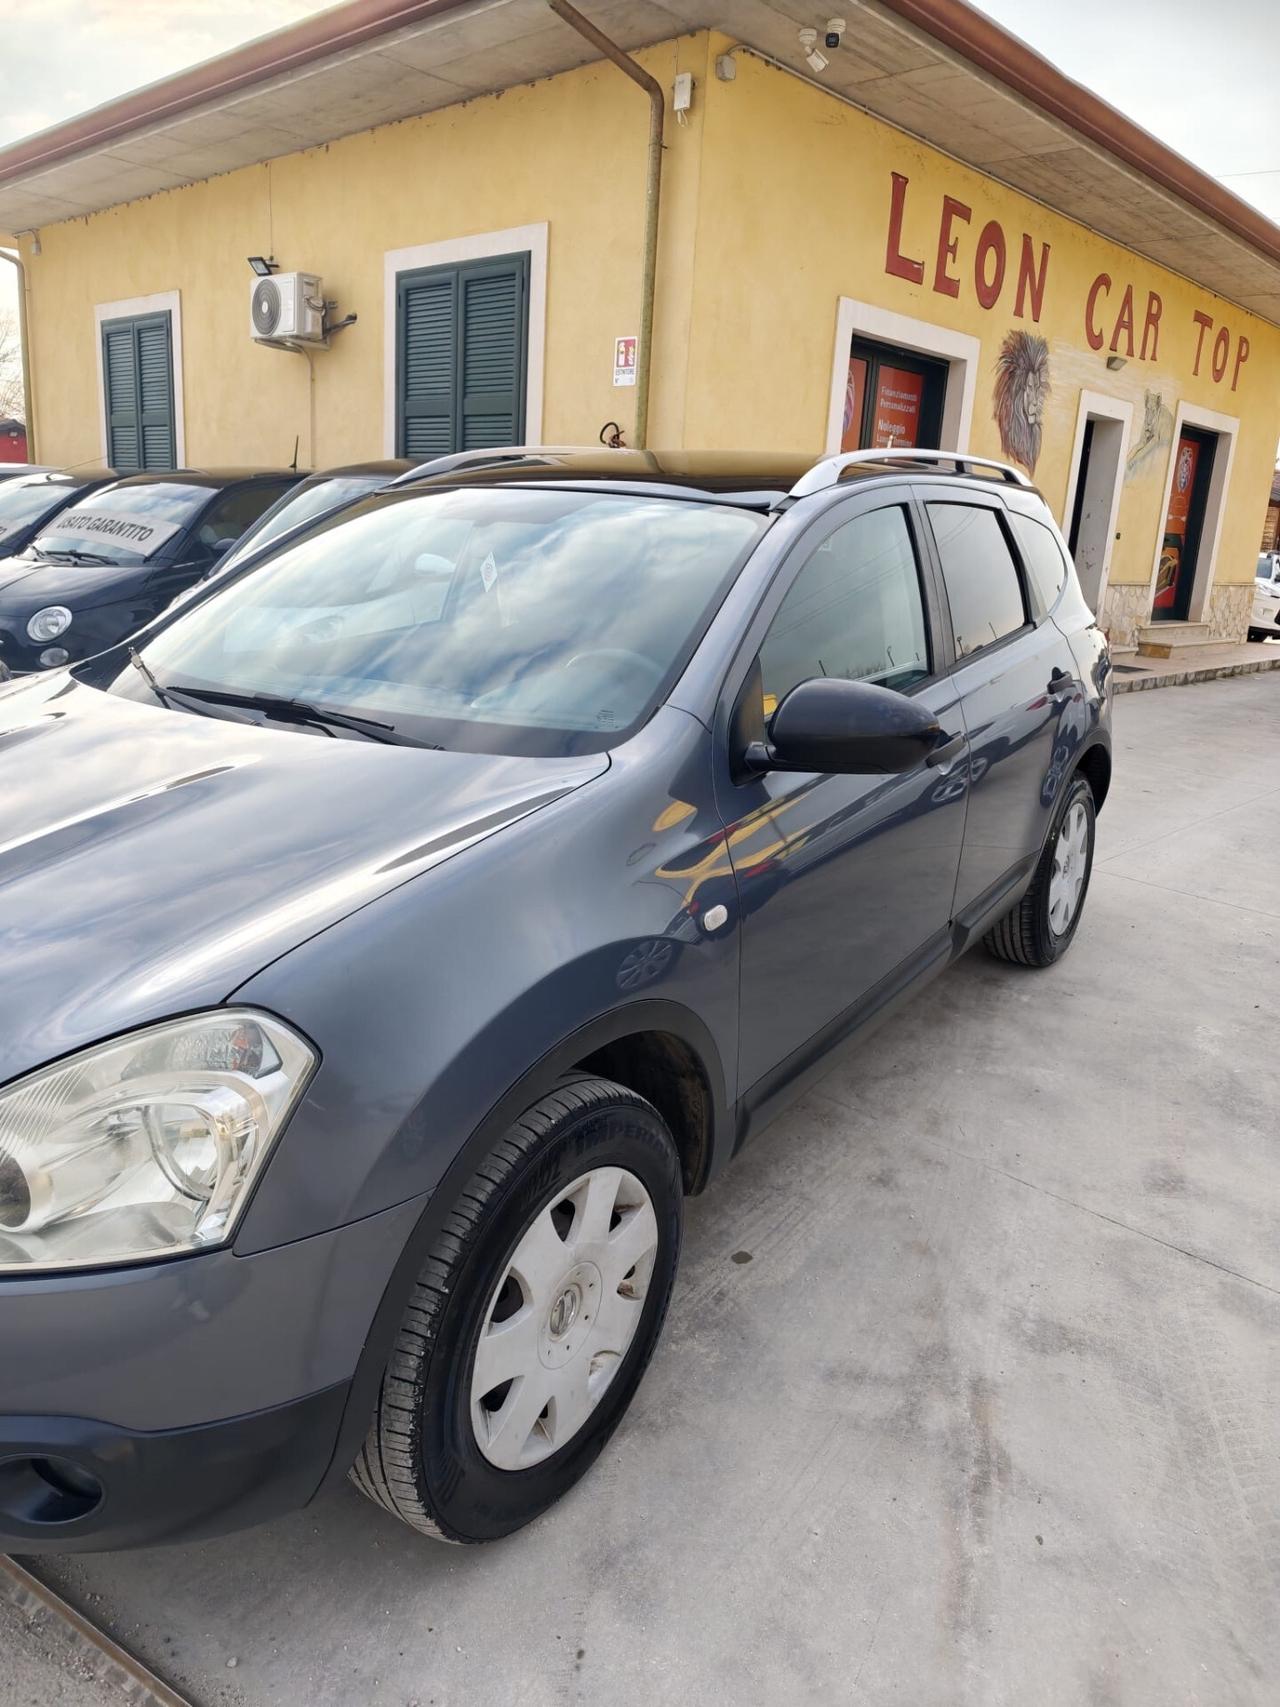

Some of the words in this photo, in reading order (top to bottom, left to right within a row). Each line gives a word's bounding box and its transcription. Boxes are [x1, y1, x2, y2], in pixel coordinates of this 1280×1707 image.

[885, 171, 1050, 323] LEON
[1085, 273, 1163, 361] CAR
[1193, 310, 1250, 392] TOP
[878, 418, 905, 435] Noleggio
[86, 517, 154, 542] GARANTITO
